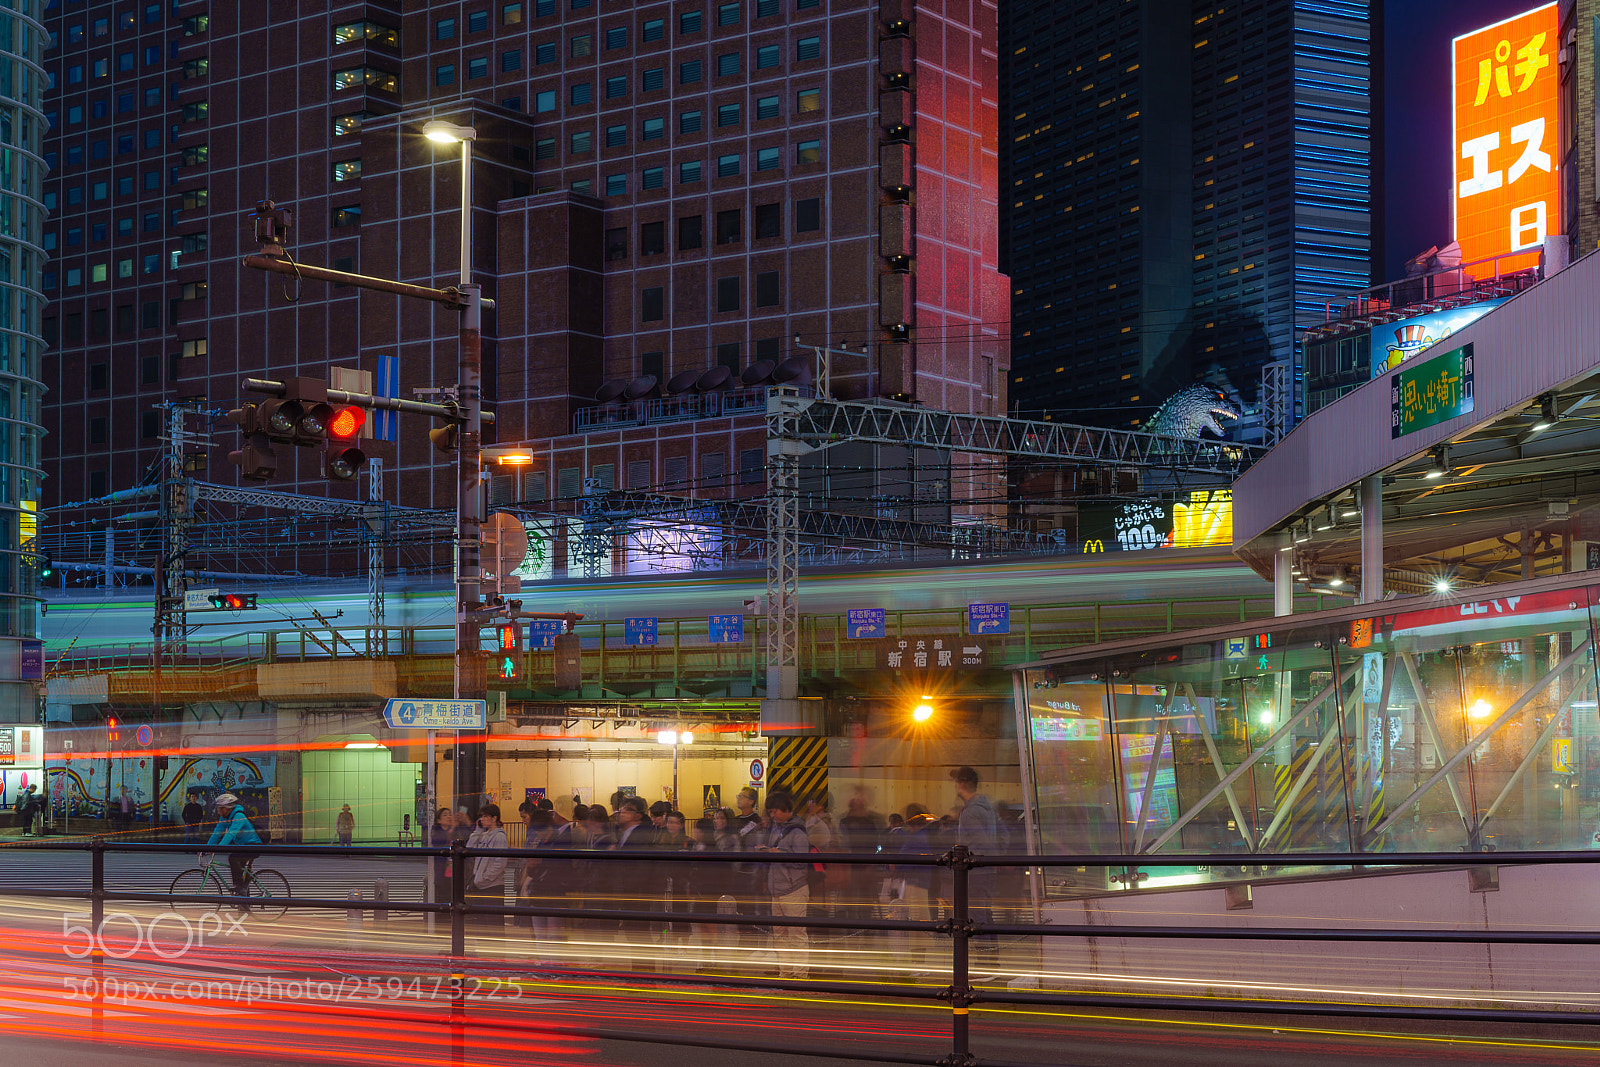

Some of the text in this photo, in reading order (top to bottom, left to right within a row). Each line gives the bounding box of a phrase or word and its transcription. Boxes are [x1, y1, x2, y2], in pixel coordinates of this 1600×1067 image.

[1473, 32, 1549, 107] パチ
[1459, 117, 1558, 198] エス
[1464, 355, 1473, 400] 西口
[1403, 370, 1459, 423] 思い出横丁
[1391, 386, 1399, 427] 新宿
[1114, 506, 1165, 530] じゃがいも
[1117, 523, 1169, 552] 100%
[850, 610, 882, 619] 新宿駅東口
[971, 604, 1006, 614] 新宿駅東口
[898, 639, 943, 650] 中央線
[887, 651, 952, 668] 新宿駅
[962, 657, 982, 665] 300M
[403, 706, 413, 720] 4
[423, 703, 474, 717] 青梅街道
[461, 717, 475, 725] Ave.
